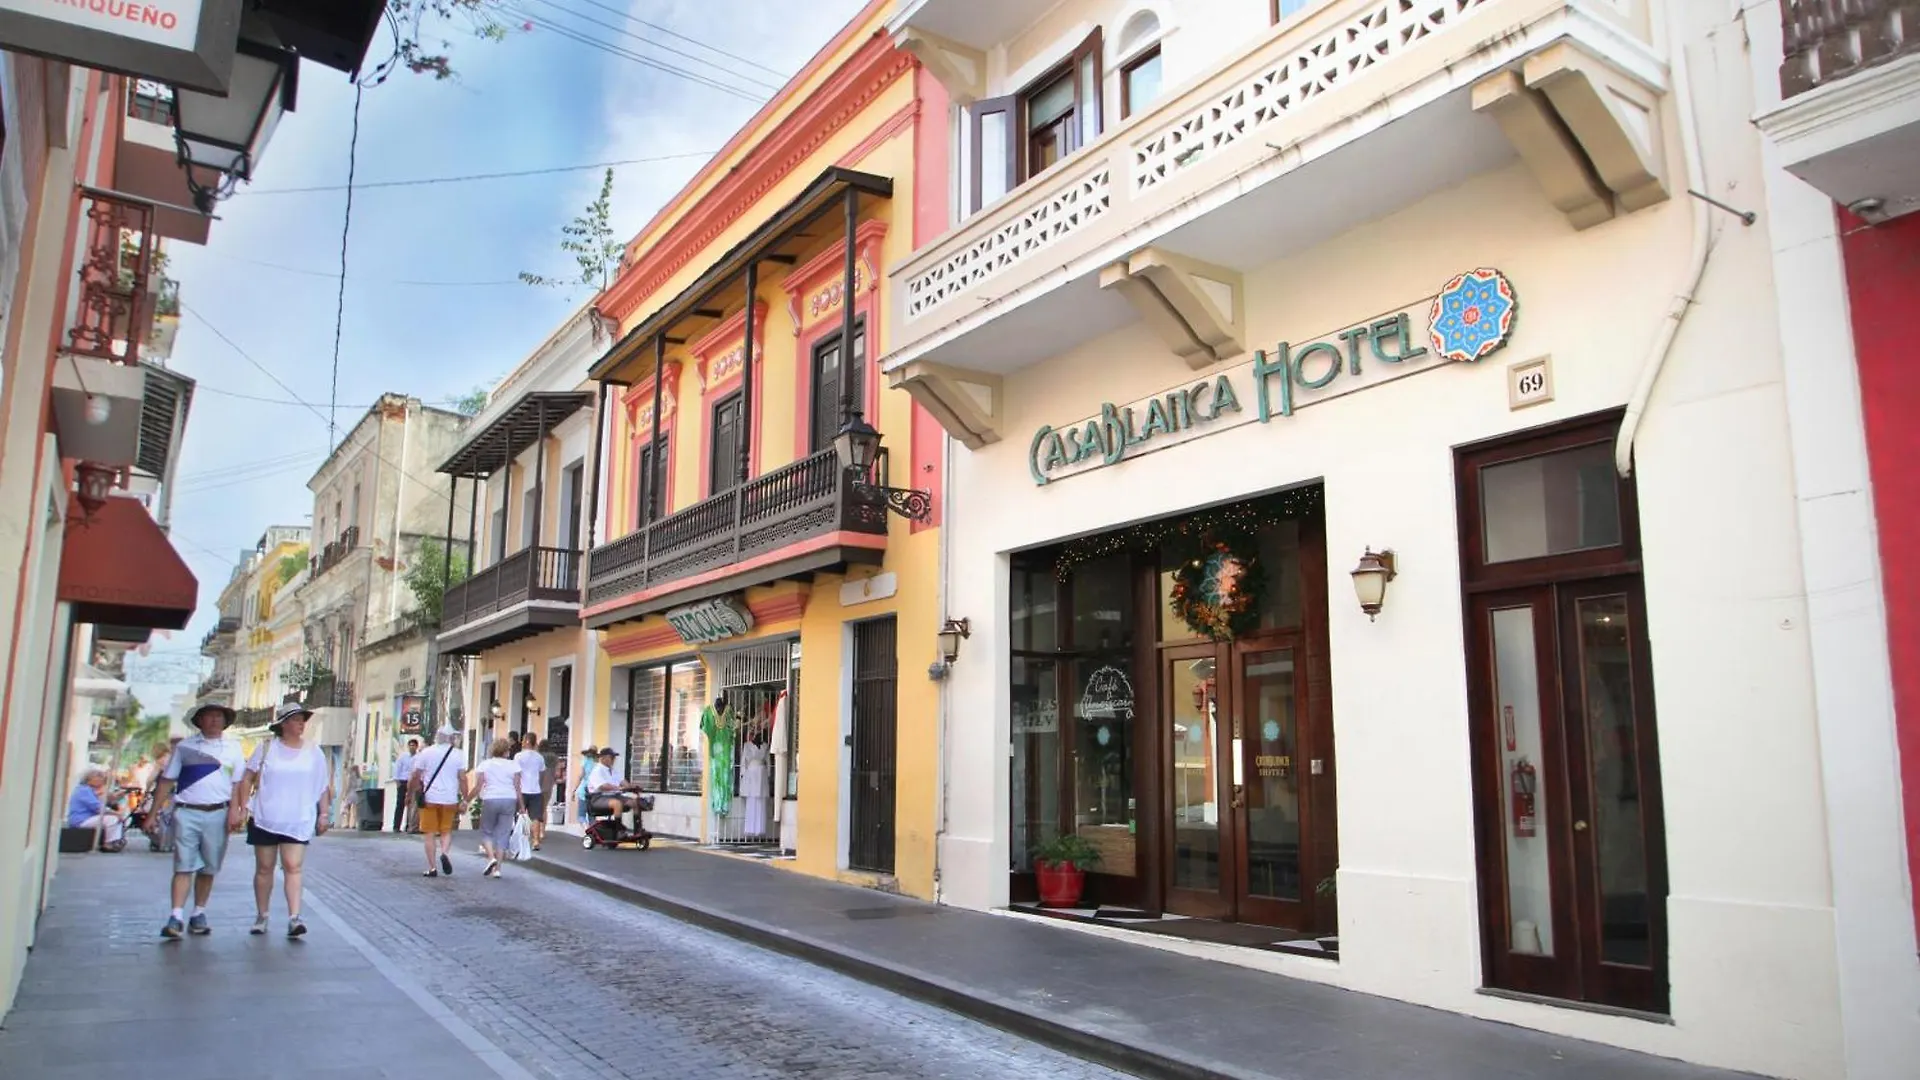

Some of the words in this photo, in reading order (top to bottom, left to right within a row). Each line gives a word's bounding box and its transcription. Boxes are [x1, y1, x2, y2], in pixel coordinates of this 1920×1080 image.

[1252, 311, 1427, 423] HOTEL
[1519, 373, 1543, 395] 69
[406, 713, 420, 724] 15
